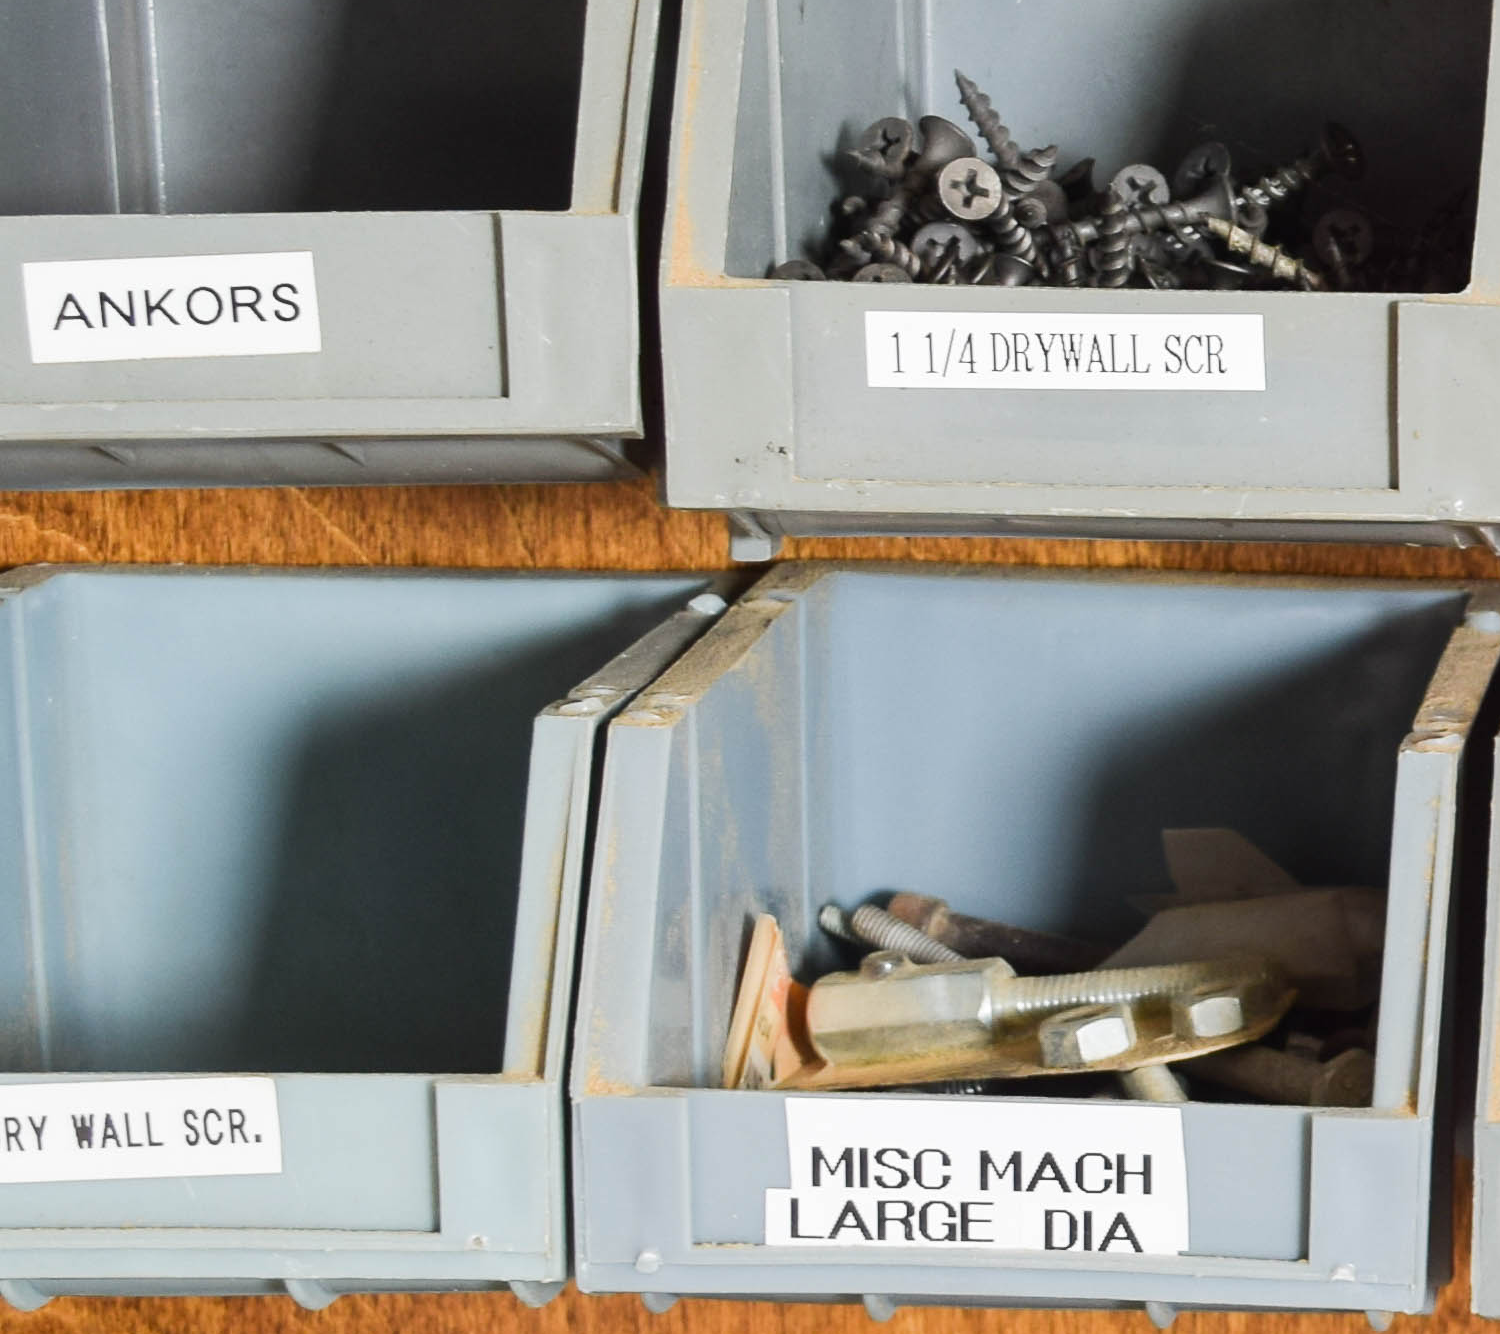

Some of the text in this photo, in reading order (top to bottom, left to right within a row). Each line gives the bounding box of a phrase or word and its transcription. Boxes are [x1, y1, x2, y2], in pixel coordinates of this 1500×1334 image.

[53, 282, 301, 331] ANKORS
[890, 328, 1228, 378] 1 1/4 DRYWALL SCR
[70, 1111, 165, 1150] WALL
[183, 1108, 262, 1147] SCR.
[811, 1146, 1153, 1195] MISC MACH
[790, 1197, 1144, 1254] LARGE DIA
